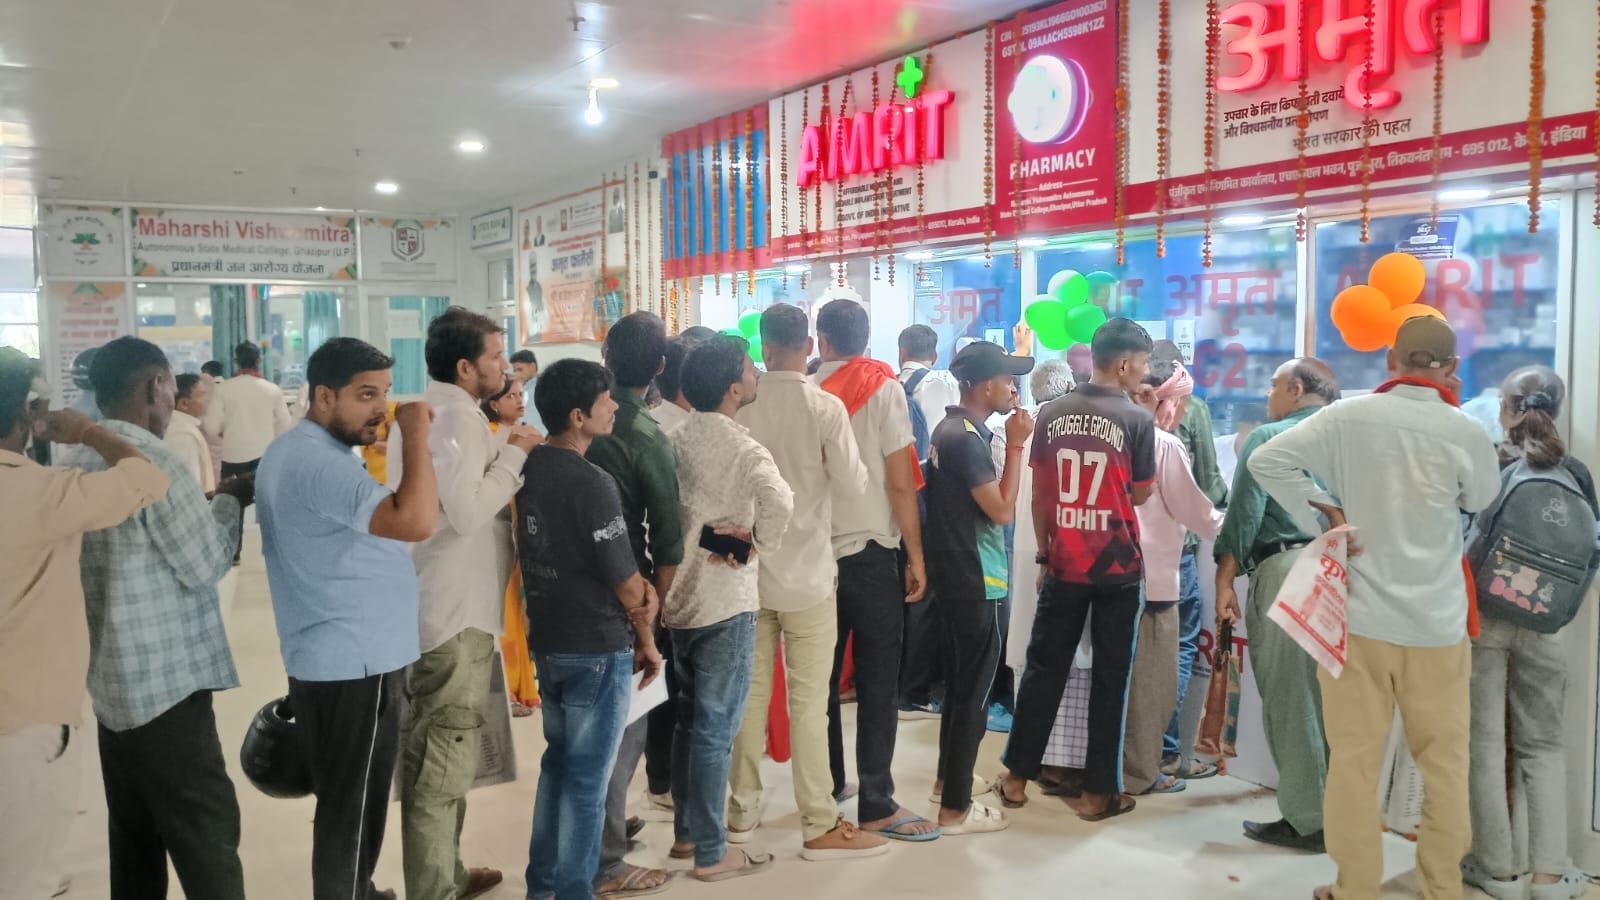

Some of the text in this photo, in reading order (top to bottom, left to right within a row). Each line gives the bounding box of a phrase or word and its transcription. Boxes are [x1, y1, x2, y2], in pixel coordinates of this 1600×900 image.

[1224, 108, 1249, 122] उपचार
[1250, 104, 1259, 117] के
[1260, 101, 1278, 116] लिए
[797, 90, 955, 188] AMRIT
[1224, 123, 1239, 138] और
[1322, 126, 1361, 144] सरकार
[1383, 118, 1411, 136] पहल
[1462, 143, 1484, 156] 695
[1488, 138, 1512, 153] 012,
[1550, 125, 1587, 146] इंडिया
[1010, 148, 1095, 180] PHARMACY
[138, 218, 350, 242] Maharshi Vishmitra
[226, 262, 247, 273] जन
[291, 260, 325, 273] योजना
[1166, 269, 1282, 336] अमृत
[1193, 339, 1247, 389] C2
[1047, 415, 1124, 453] STRUGGLE GROUND
[1056, 448, 1107, 506] 07
